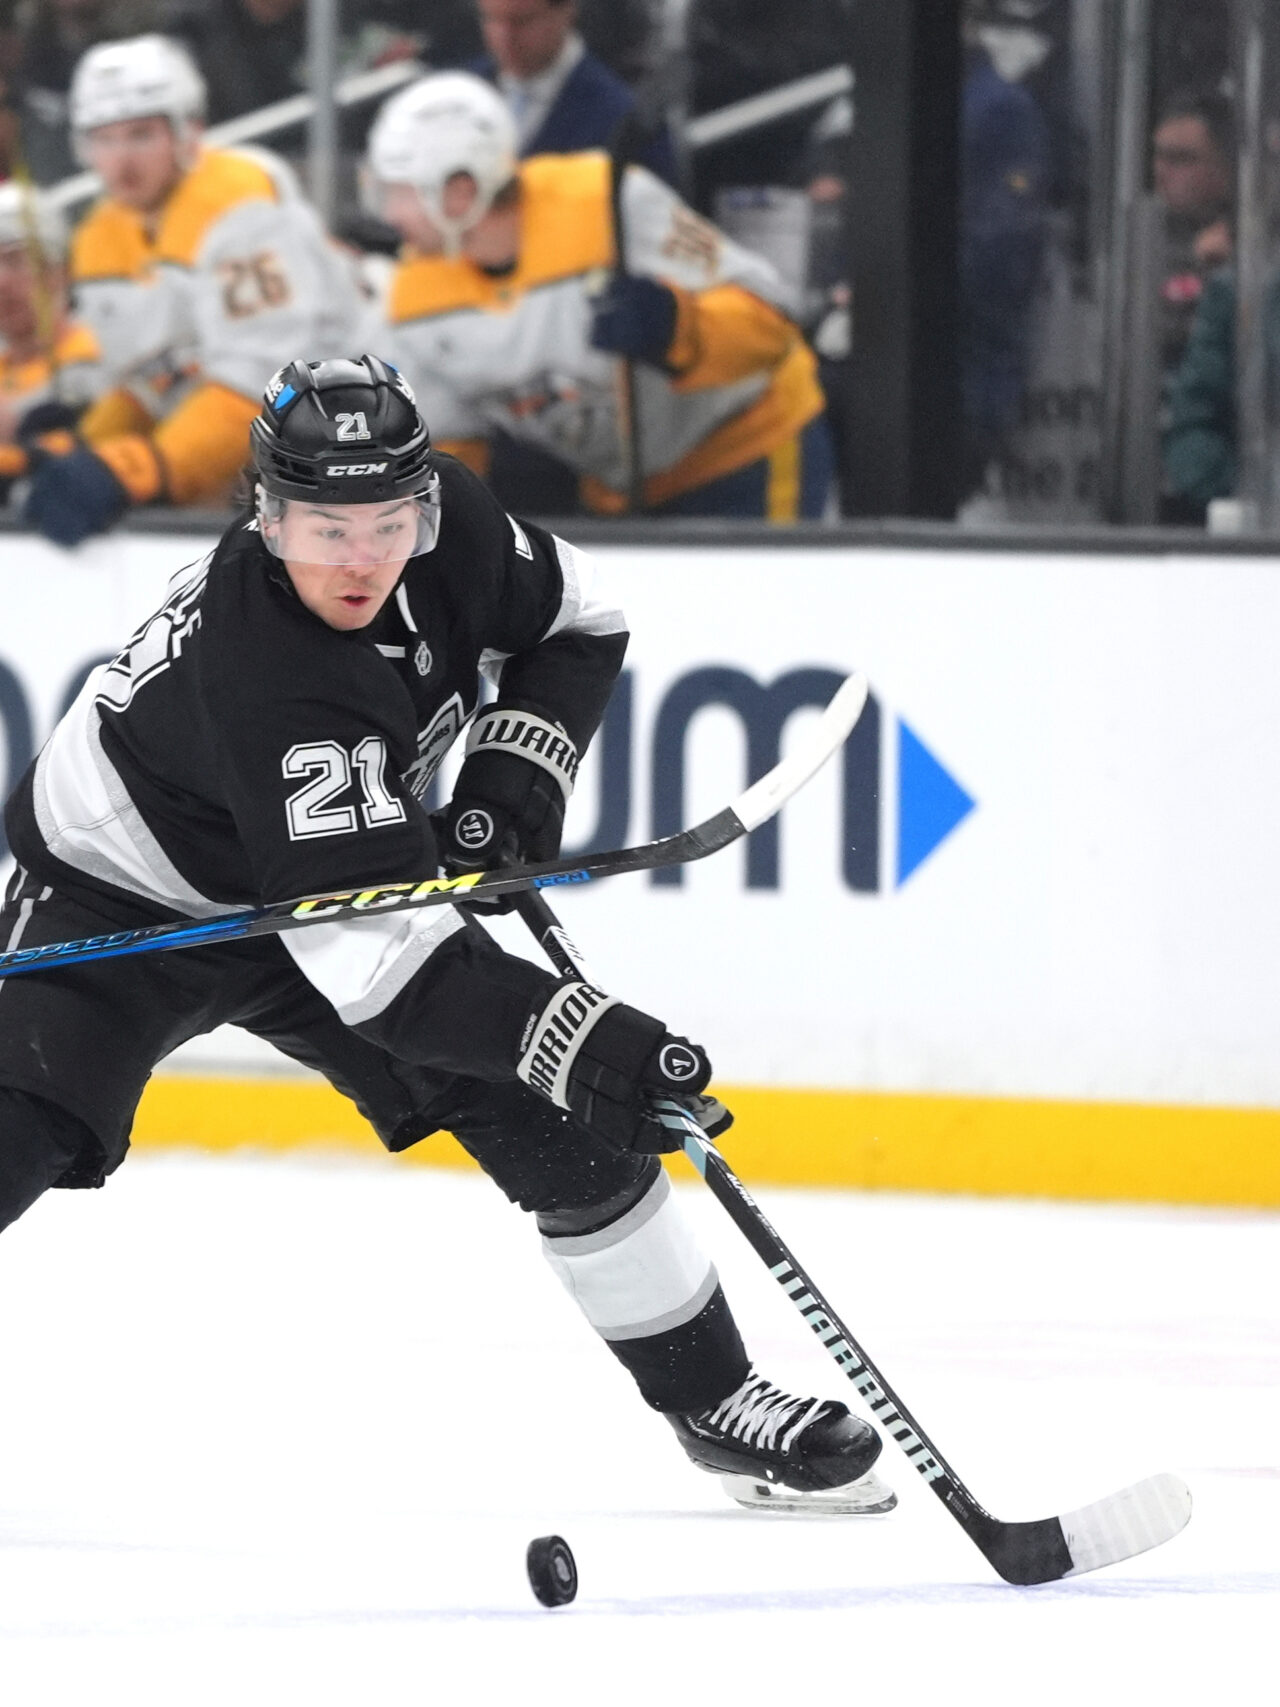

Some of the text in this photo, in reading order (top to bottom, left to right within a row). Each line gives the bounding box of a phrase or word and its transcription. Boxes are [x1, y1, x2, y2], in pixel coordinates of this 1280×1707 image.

[214, 250, 294, 322] 26
[334, 411, 372, 442] 21
[326, 462, 389, 477] CCM
[281, 736, 407, 841] 21
[292, 872, 486, 921] CCM
[770, 1259, 946, 1483] WARRIOR
